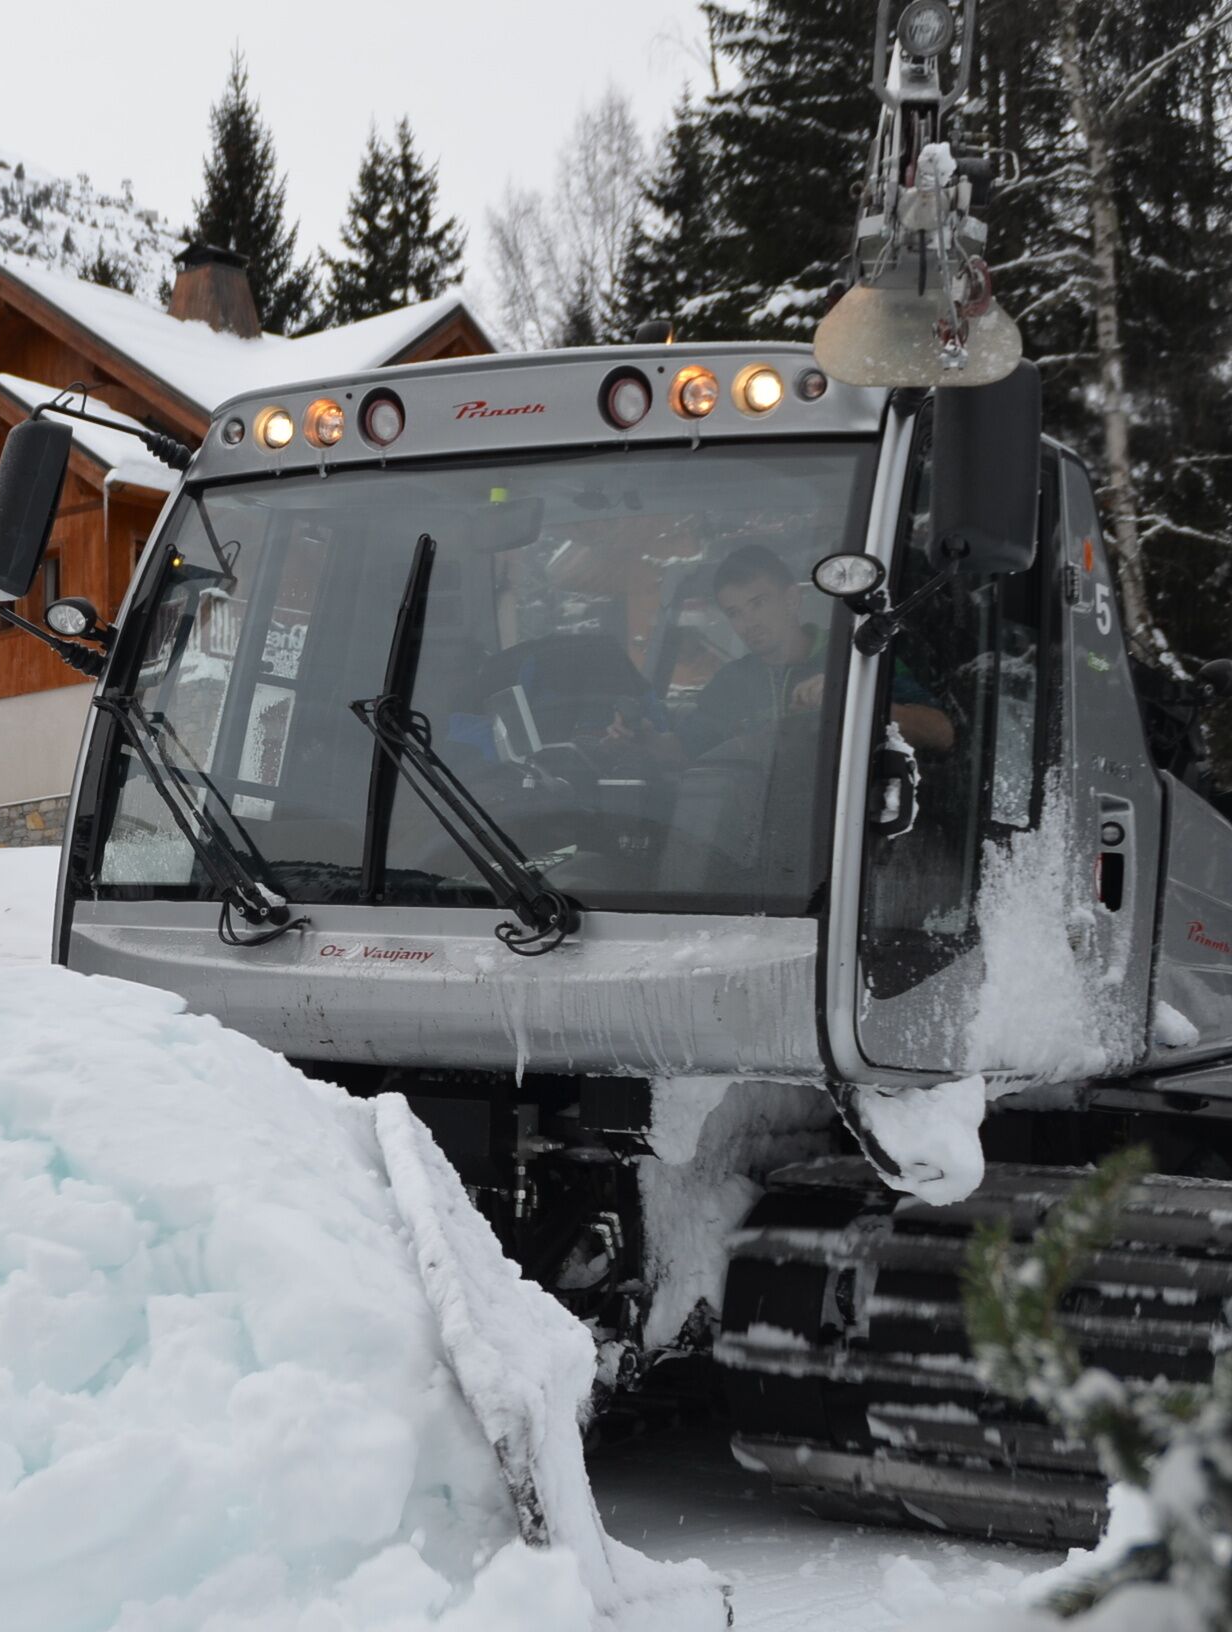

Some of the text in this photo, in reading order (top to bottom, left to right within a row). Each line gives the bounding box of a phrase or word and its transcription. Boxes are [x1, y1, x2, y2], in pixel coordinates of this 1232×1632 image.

[452, 400, 546, 419] Prinoth
[1094, 583, 1112, 636] 5
[320, 944, 434, 963] Oz Vaujany
